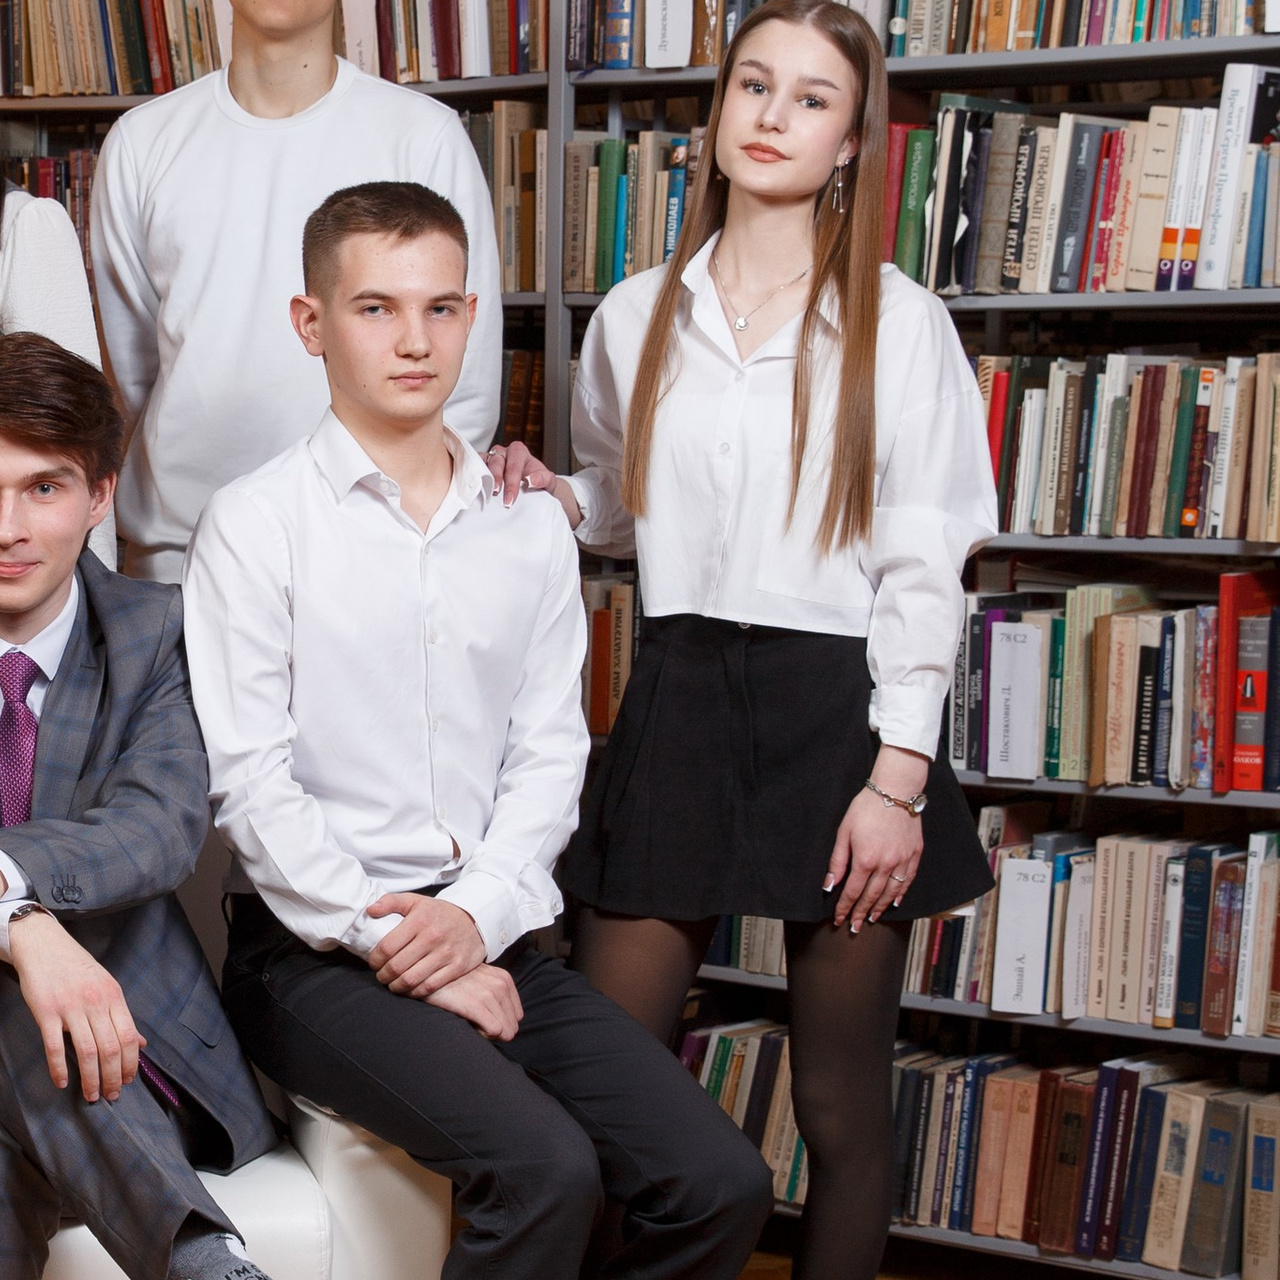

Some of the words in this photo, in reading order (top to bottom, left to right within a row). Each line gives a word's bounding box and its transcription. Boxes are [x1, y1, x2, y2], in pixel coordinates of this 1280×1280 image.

[1224, 88, 1240, 126] Время
[1219, 128, 1236, 169] Сергея
[906, 141, 923, 211] АВТОБИОГРАФИЯ
[1009, 144, 1031, 223] ПРОКОФЬЕВ
[1028, 144, 1051, 220] ПРОКОФЬЕВ
[665, 196, 679, 251] НИКОЛАЕВ
[1208, 172, 1229, 246] Прокофьева
[1025, 226, 1040, 272] СЕРГЕЙ
[954, 643, 965, 707] АЛЬФРЕДОМ
[999, 685, 1011, 696] Д.
[1140, 674, 1153, 731] ШОСТАКОВИЧ
[954, 715, 964, 759] БЕСЕДЫ
[999, 697, 1010, 763] Шостакович
[1070, 759, 1079, 771] 2
[1137, 734, 1149, 775] ДМИТРИЙ
[1233, 755, 1262, 765] ОЛКОВ
[1016, 871, 1031, 882] 78
[1014, 953, 1026, 967] А.
[1011, 966, 1025, 1002] Эшпай
